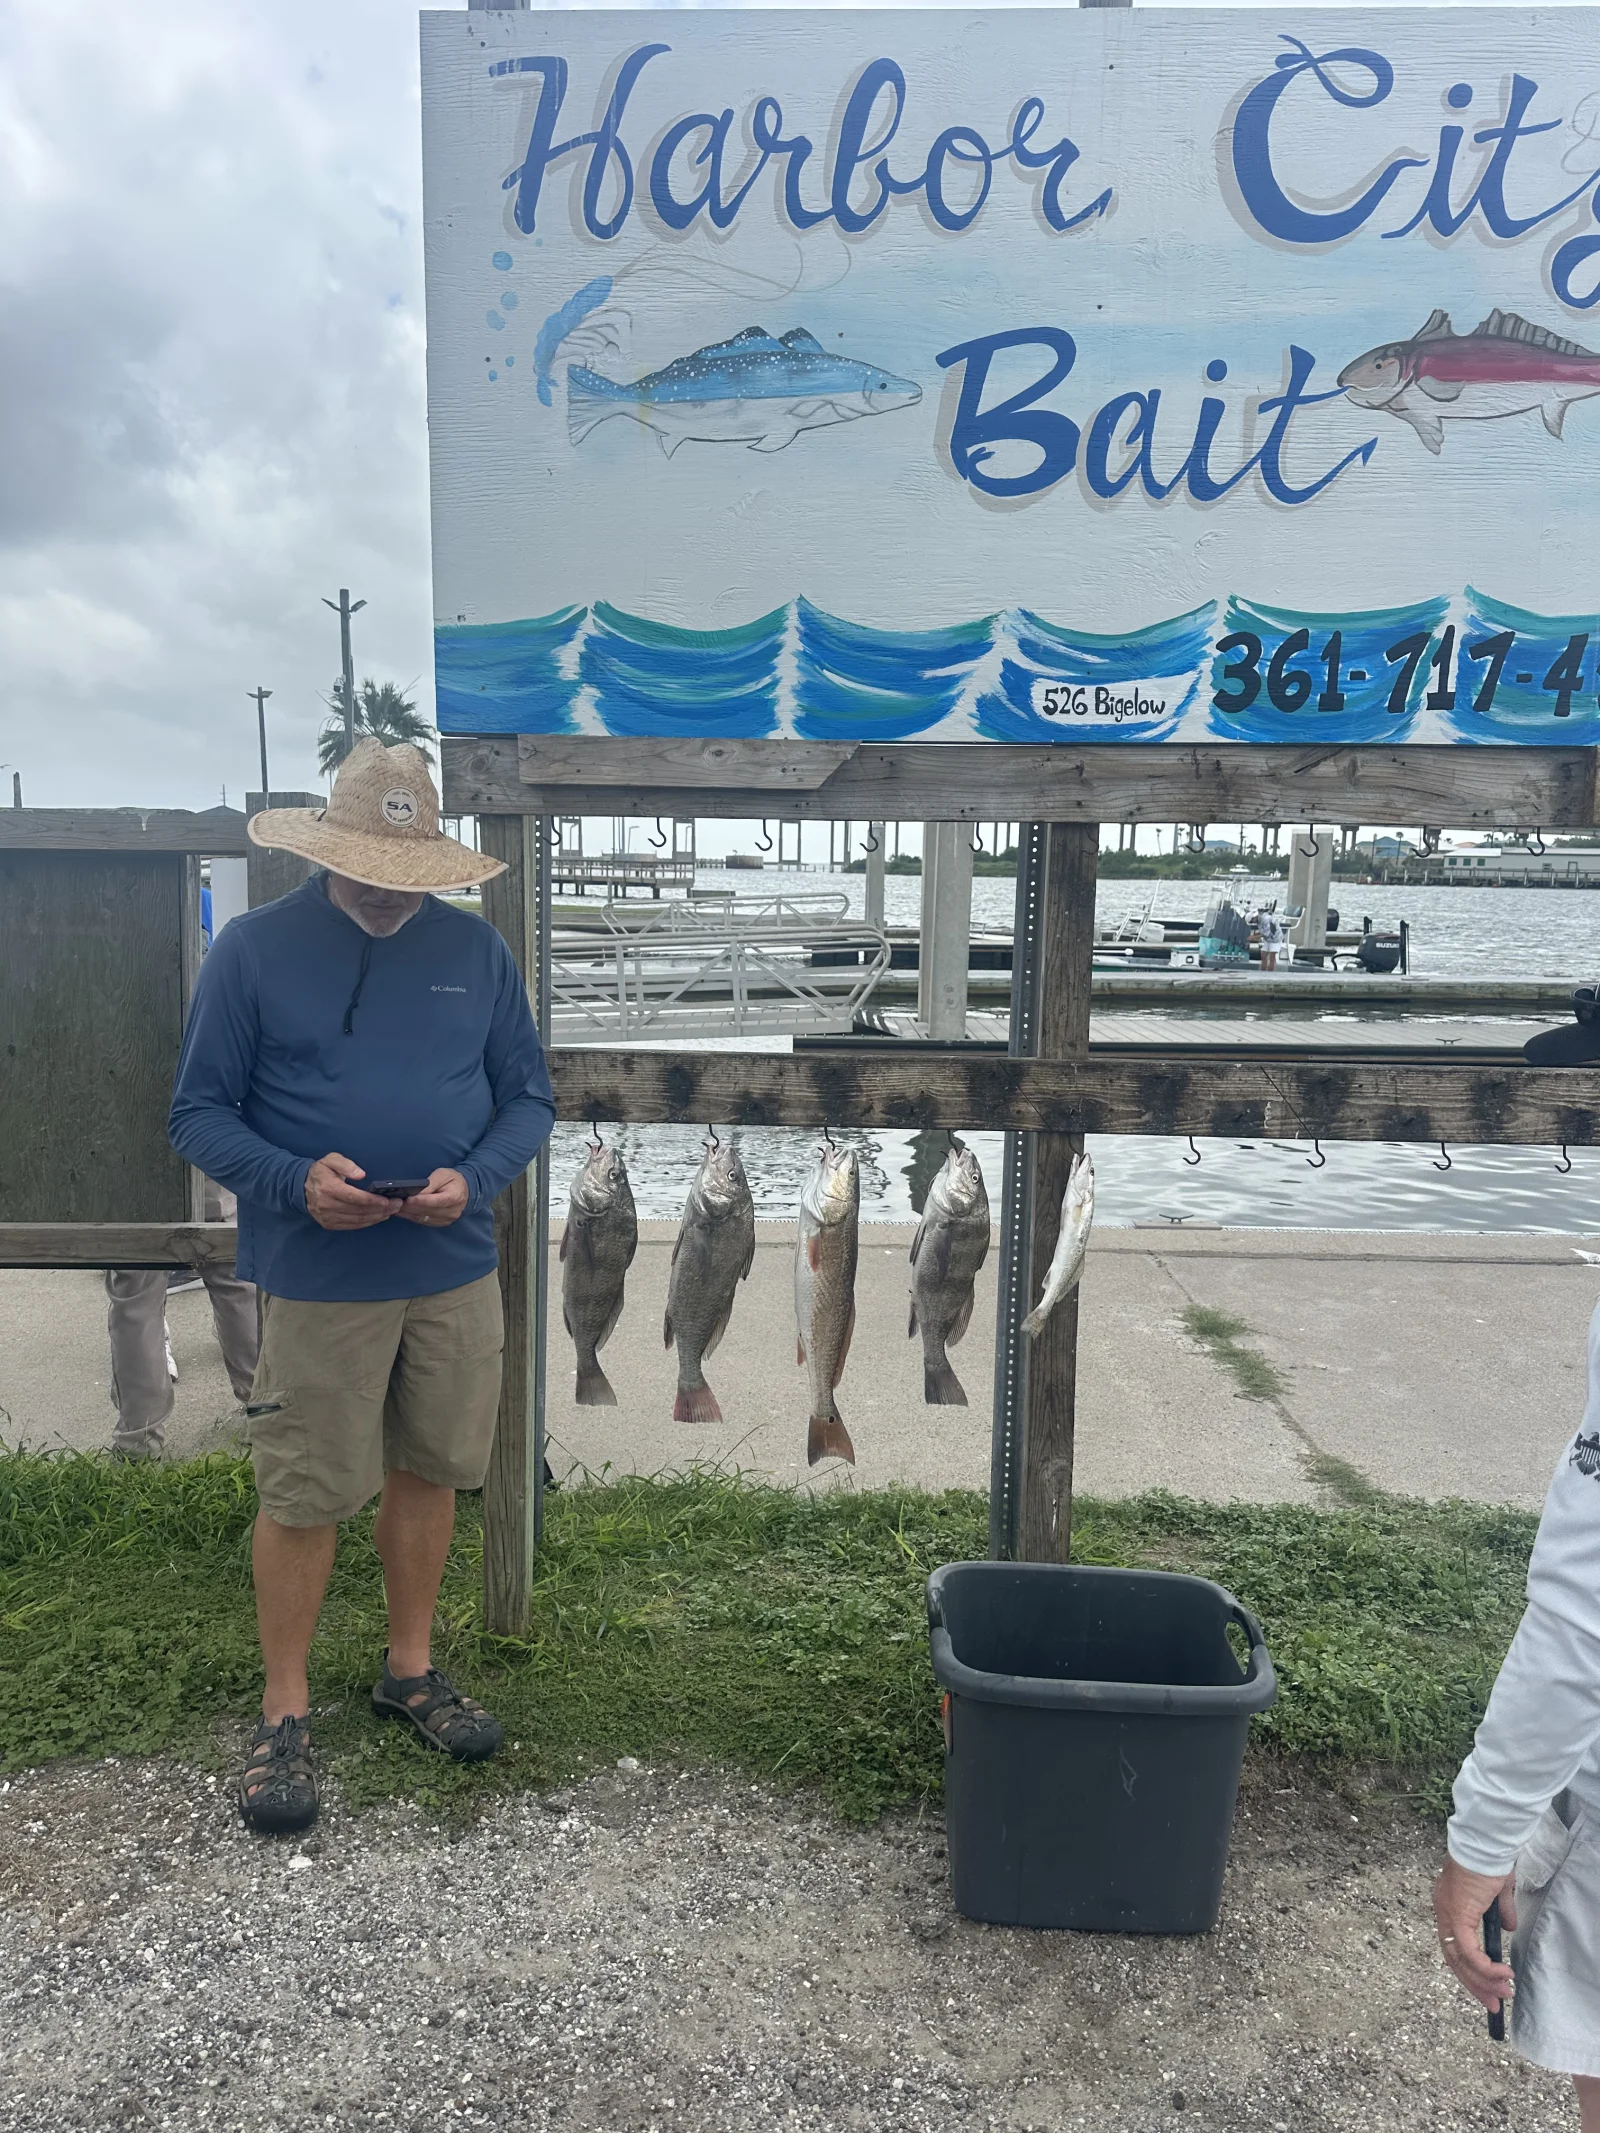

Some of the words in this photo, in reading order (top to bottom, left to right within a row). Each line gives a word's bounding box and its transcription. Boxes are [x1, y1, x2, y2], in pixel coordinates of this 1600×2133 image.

[489, 43, 1112, 240] Harbor
[935, 326, 1377, 504] Bait
[1213, 625, 1600, 717] 361-717-4
[1042, 687, 1088, 716] 526
[1095, 687, 1166, 722] Bigelow
[387, 801, 412, 812] SA
[437, 985, 466, 993] Columbia
